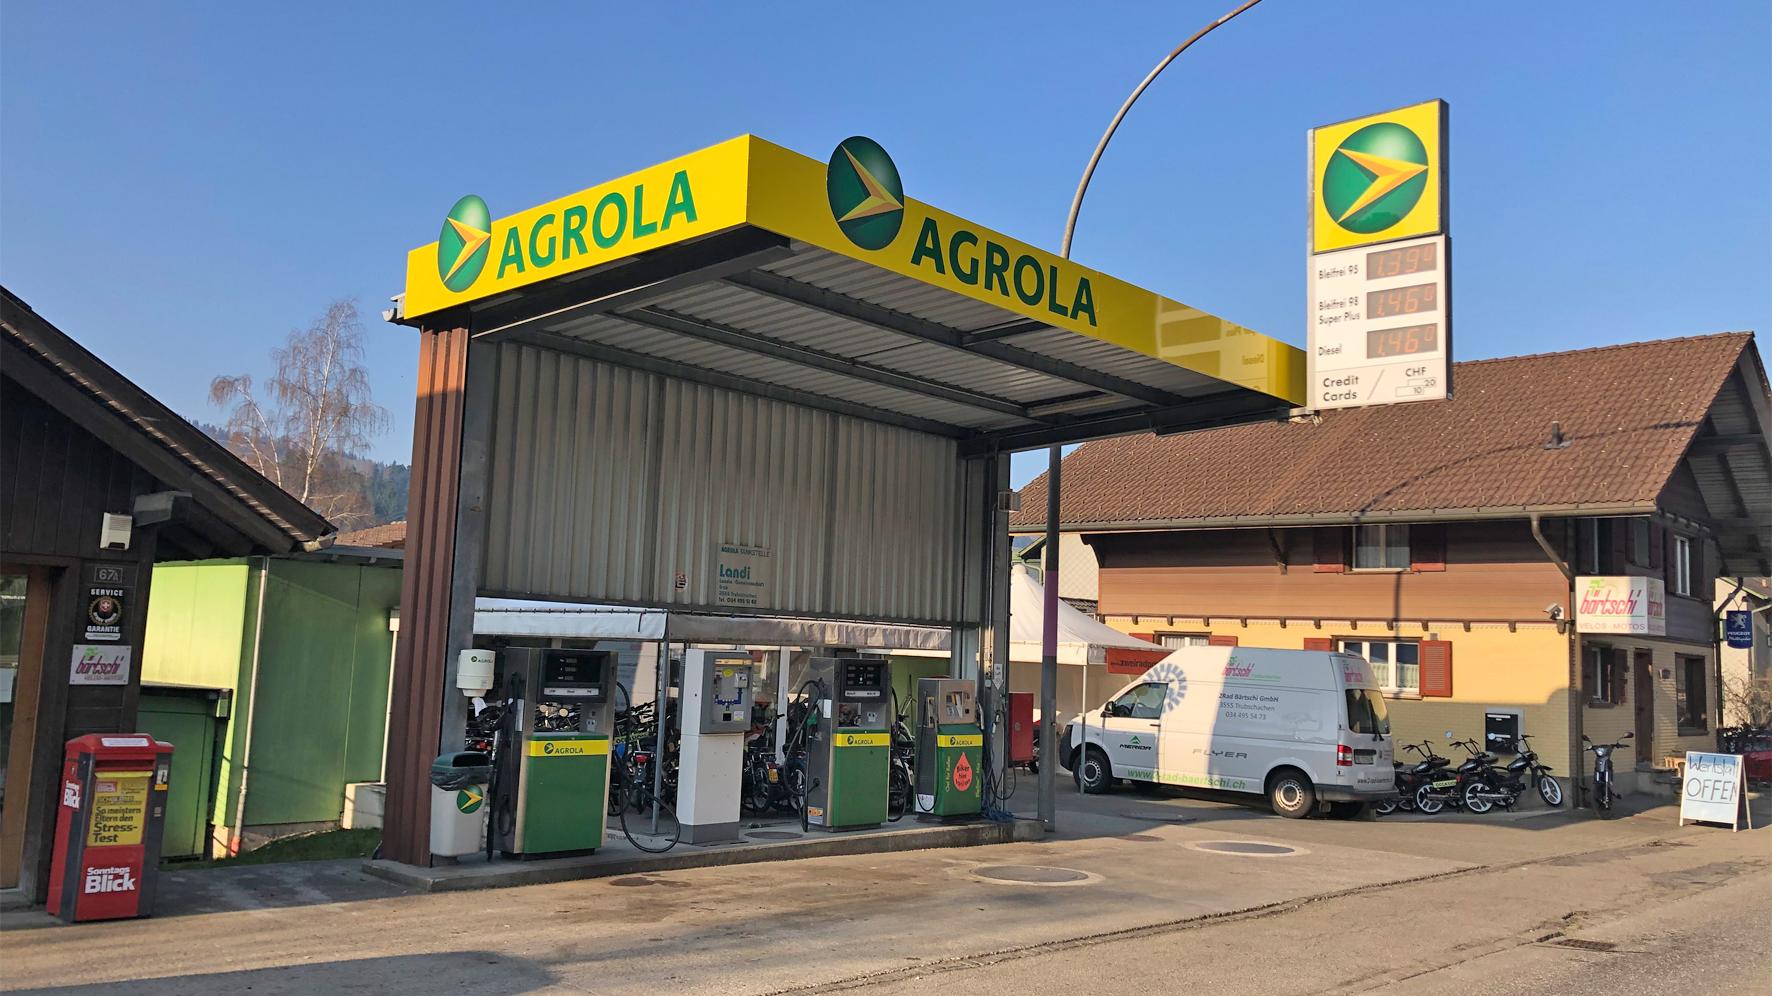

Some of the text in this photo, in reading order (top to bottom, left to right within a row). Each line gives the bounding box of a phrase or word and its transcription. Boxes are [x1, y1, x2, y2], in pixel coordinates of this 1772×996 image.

[496, 169, 698, 280] AGROLA
[910, 216, 1098, 327] AGROLA
[1319, 264, 1358, 280] Bleifrei 95
[1319, 296, 1358, 311] Bleifrei 98
[1319, 312, 1360, 326] Super Plus
[1318, 344, 1342, 356] Diesel
[1405, 366, 1427, 377] CHF
[1323, 375, 1359, 388] Credit
[1424, 379, 1436, 388] 20
[1323, 389, 1358, 402] Cards
[1413, 386, 1423, 395] 10
[720, 563, 750, 580] Landi
[90, 588, 124, 597] SERVICE
[86, 625, 120, 633] GARANTIE
[1578, 622, 1607, 630] VELOS
[1613, 622, 1646, 631] MOTOS
[1234, 693, 1259, 702] Bärtschi
[554, 746, 584, 754] AGROLA
[1192, 748, 1248, 759] FLYER
[1686, 777, 1738, 802] OFFEN
[107, 806, 142, 814] meistern
[119, 812, 134, 822] den
[94, 822, 138, 833] Stress-
[93, 831, 119, 843] Test
[87, 866, 131, 875] Sonntags
[85, 872, 136, 894] Blick
